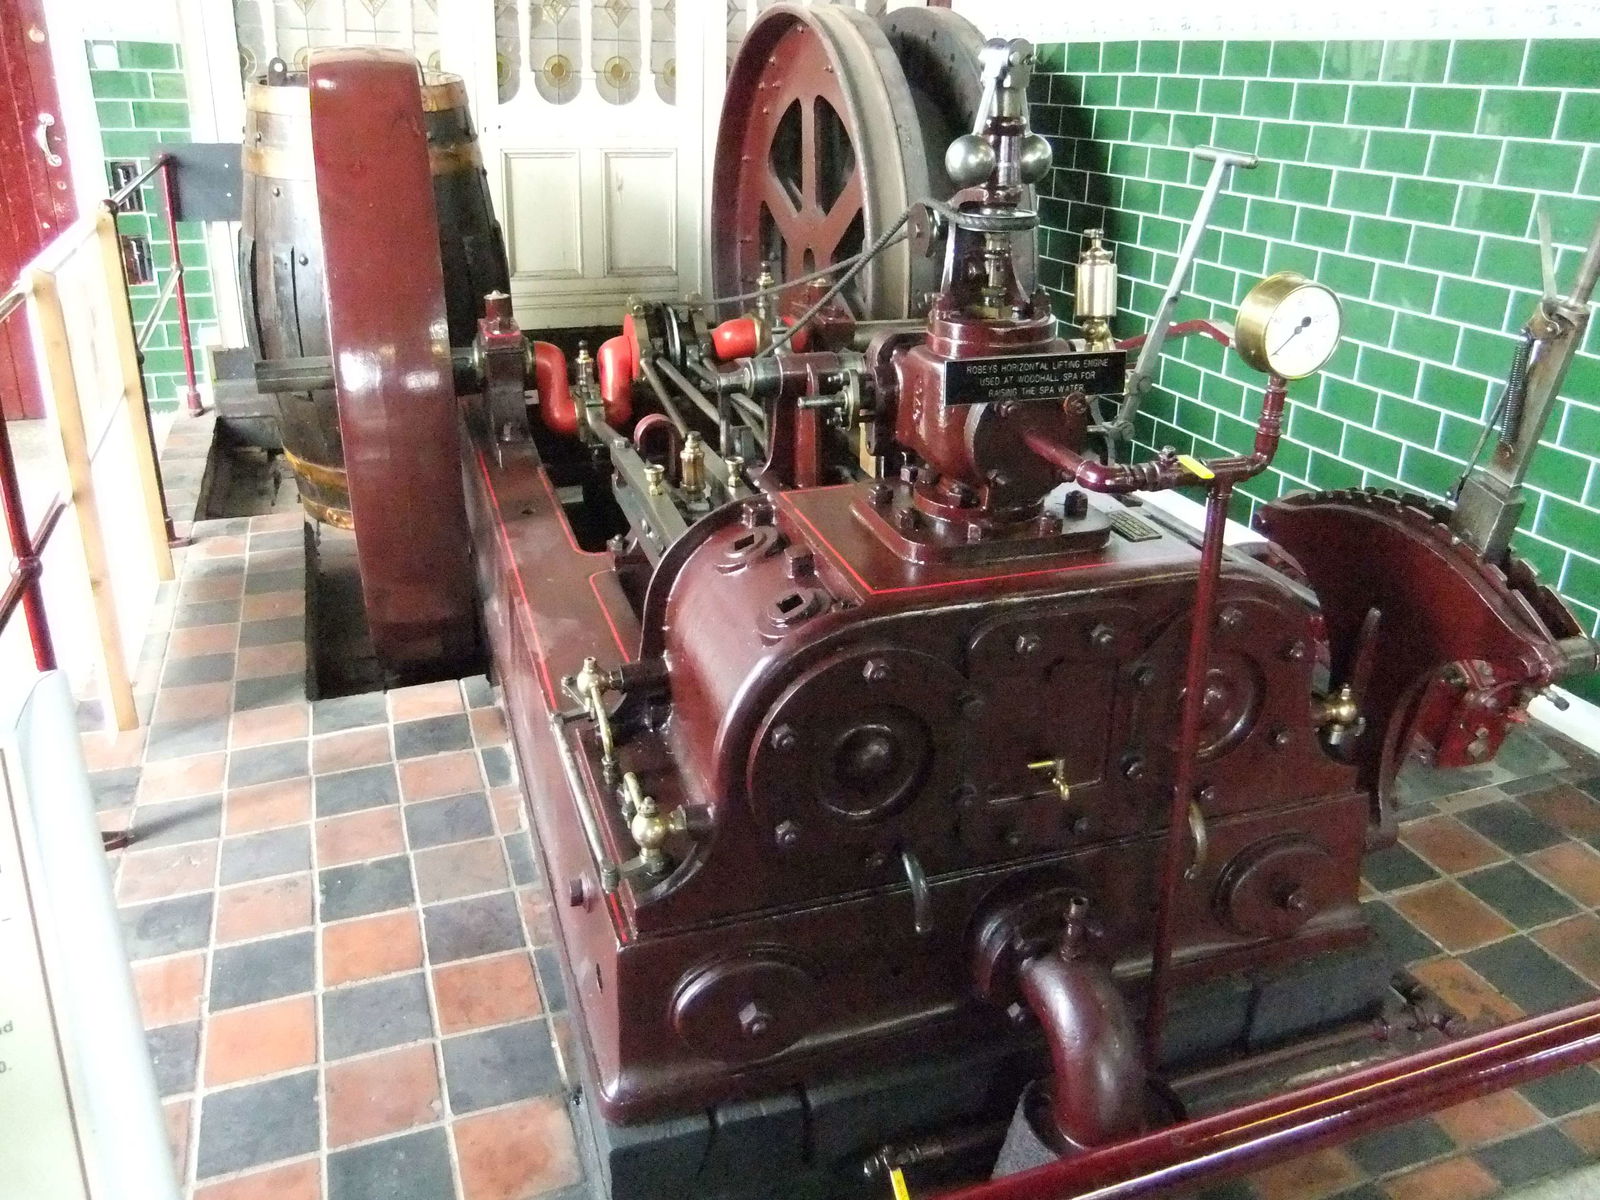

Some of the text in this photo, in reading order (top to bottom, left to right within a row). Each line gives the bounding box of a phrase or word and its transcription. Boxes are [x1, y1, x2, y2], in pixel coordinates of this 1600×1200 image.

[1001, 361, 1048, 372] HORIZONTAL
[1052, 359, 1081, 370] LIFTING
[1083, 358, 1109, 368] ENGINE
[979, 370, 1096, 386] USED AT WOODHALL SPA FOR
[988, 387, 1018, 398] RAISING
[1021, 386, 1036, 395] THE
[1039, 385, 1055, 394] SPA
